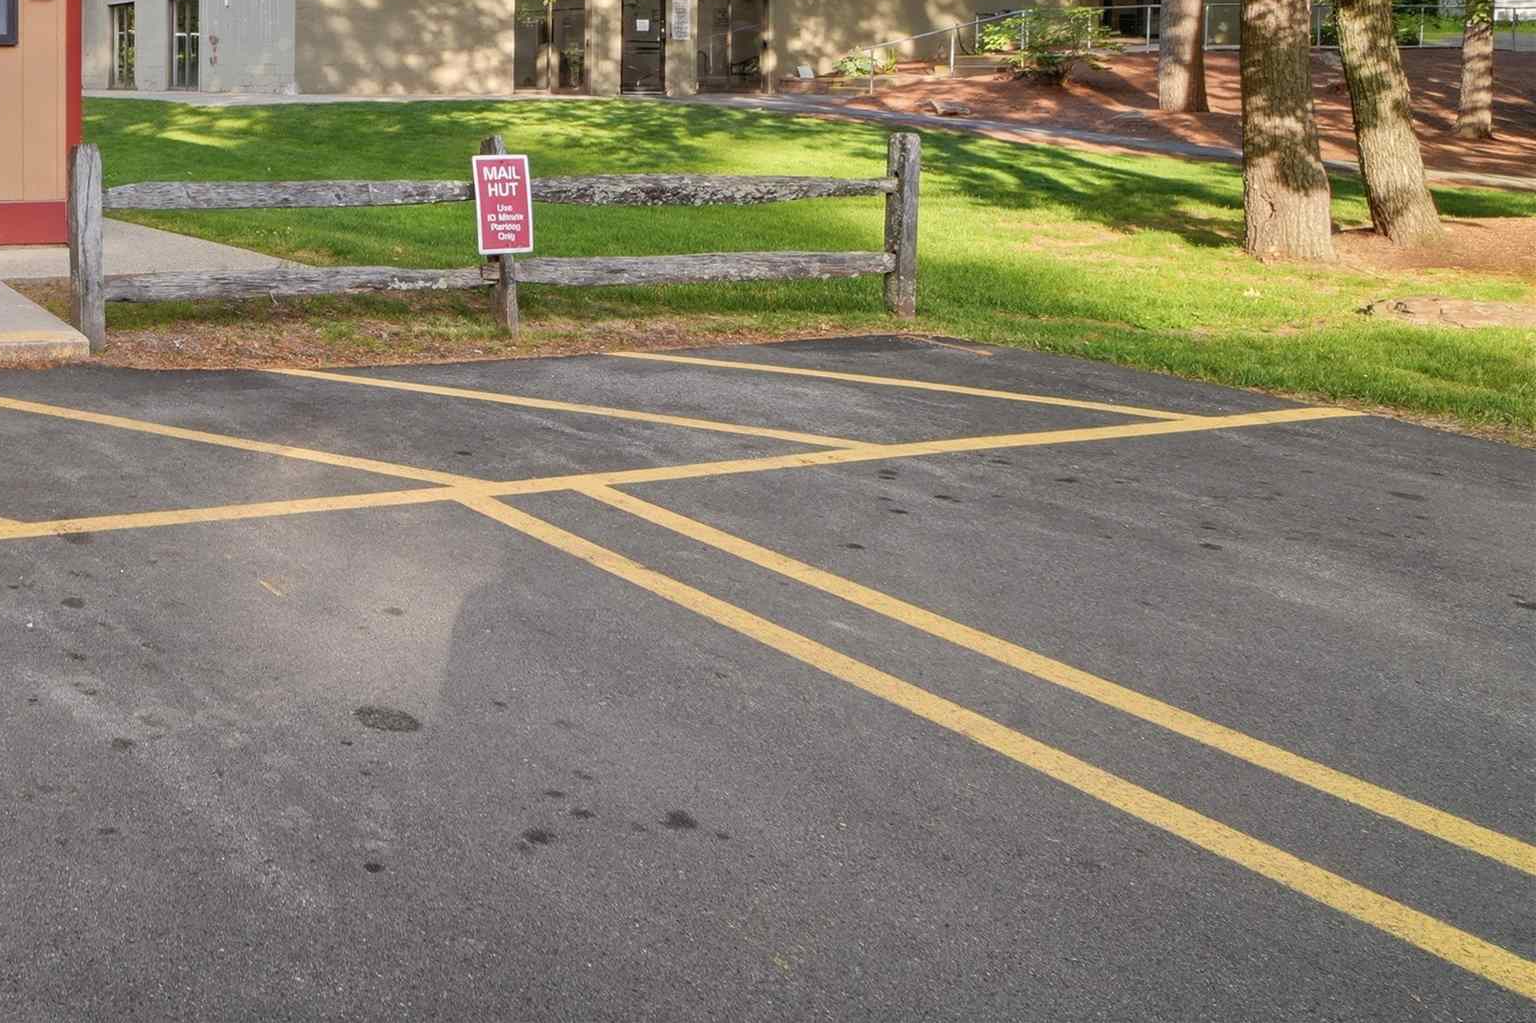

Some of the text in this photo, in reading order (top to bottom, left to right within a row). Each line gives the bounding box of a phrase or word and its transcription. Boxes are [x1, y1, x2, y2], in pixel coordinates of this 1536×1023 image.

[483, 166, 521, 181] MAIL
[488, 182, 519, 197] HUT
[487, 213, 524, 222] 10 Minute
[490, 223, 521, 232] Parking
[498, 233, 516, 242] Only
